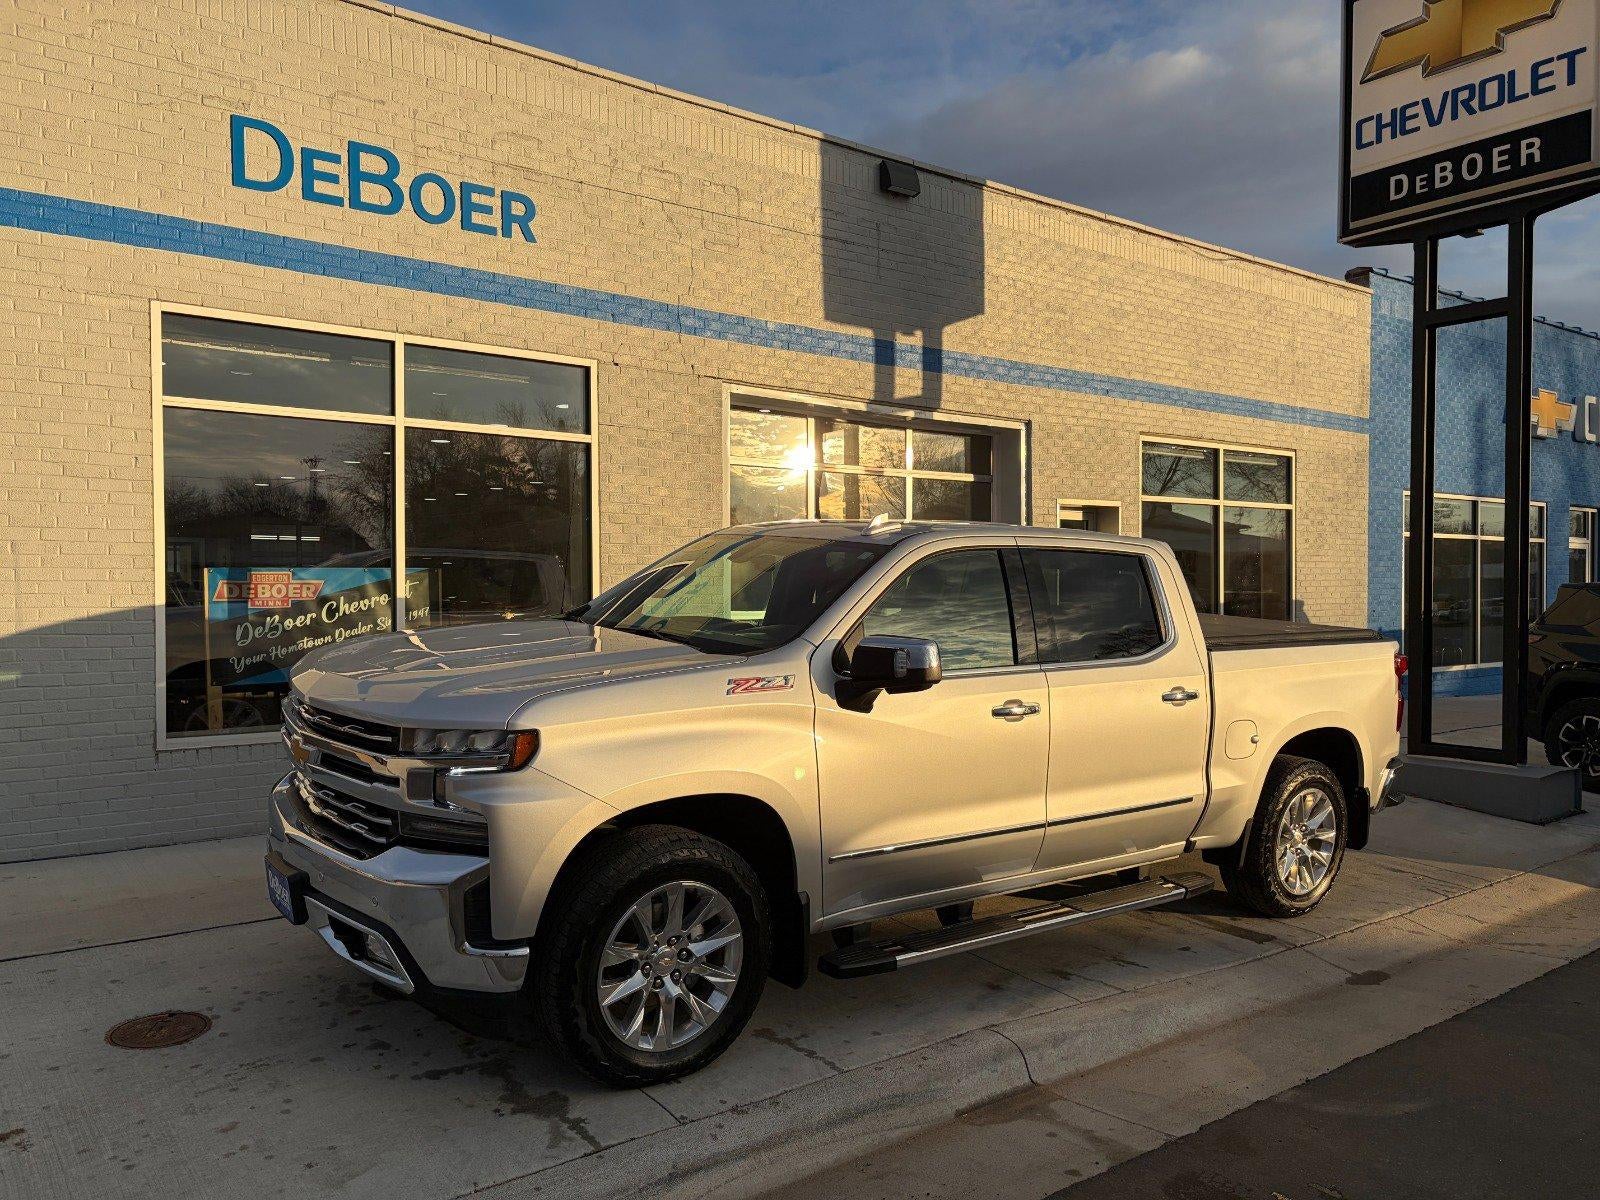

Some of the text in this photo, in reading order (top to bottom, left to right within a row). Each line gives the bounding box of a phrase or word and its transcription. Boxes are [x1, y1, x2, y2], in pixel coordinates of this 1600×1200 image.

[1355, 46, 1587, 150] CHEVROLET
[223, 583, 316, 598] DEBOER
[235, 580, 420, 646] DeBoer Chevrot
[229, 653, 267, 673] Your
[269, 635, 333, 660] Hometown
[334, 621, 374, 642] Dealer
[409, 606, 430, 621] 1947
